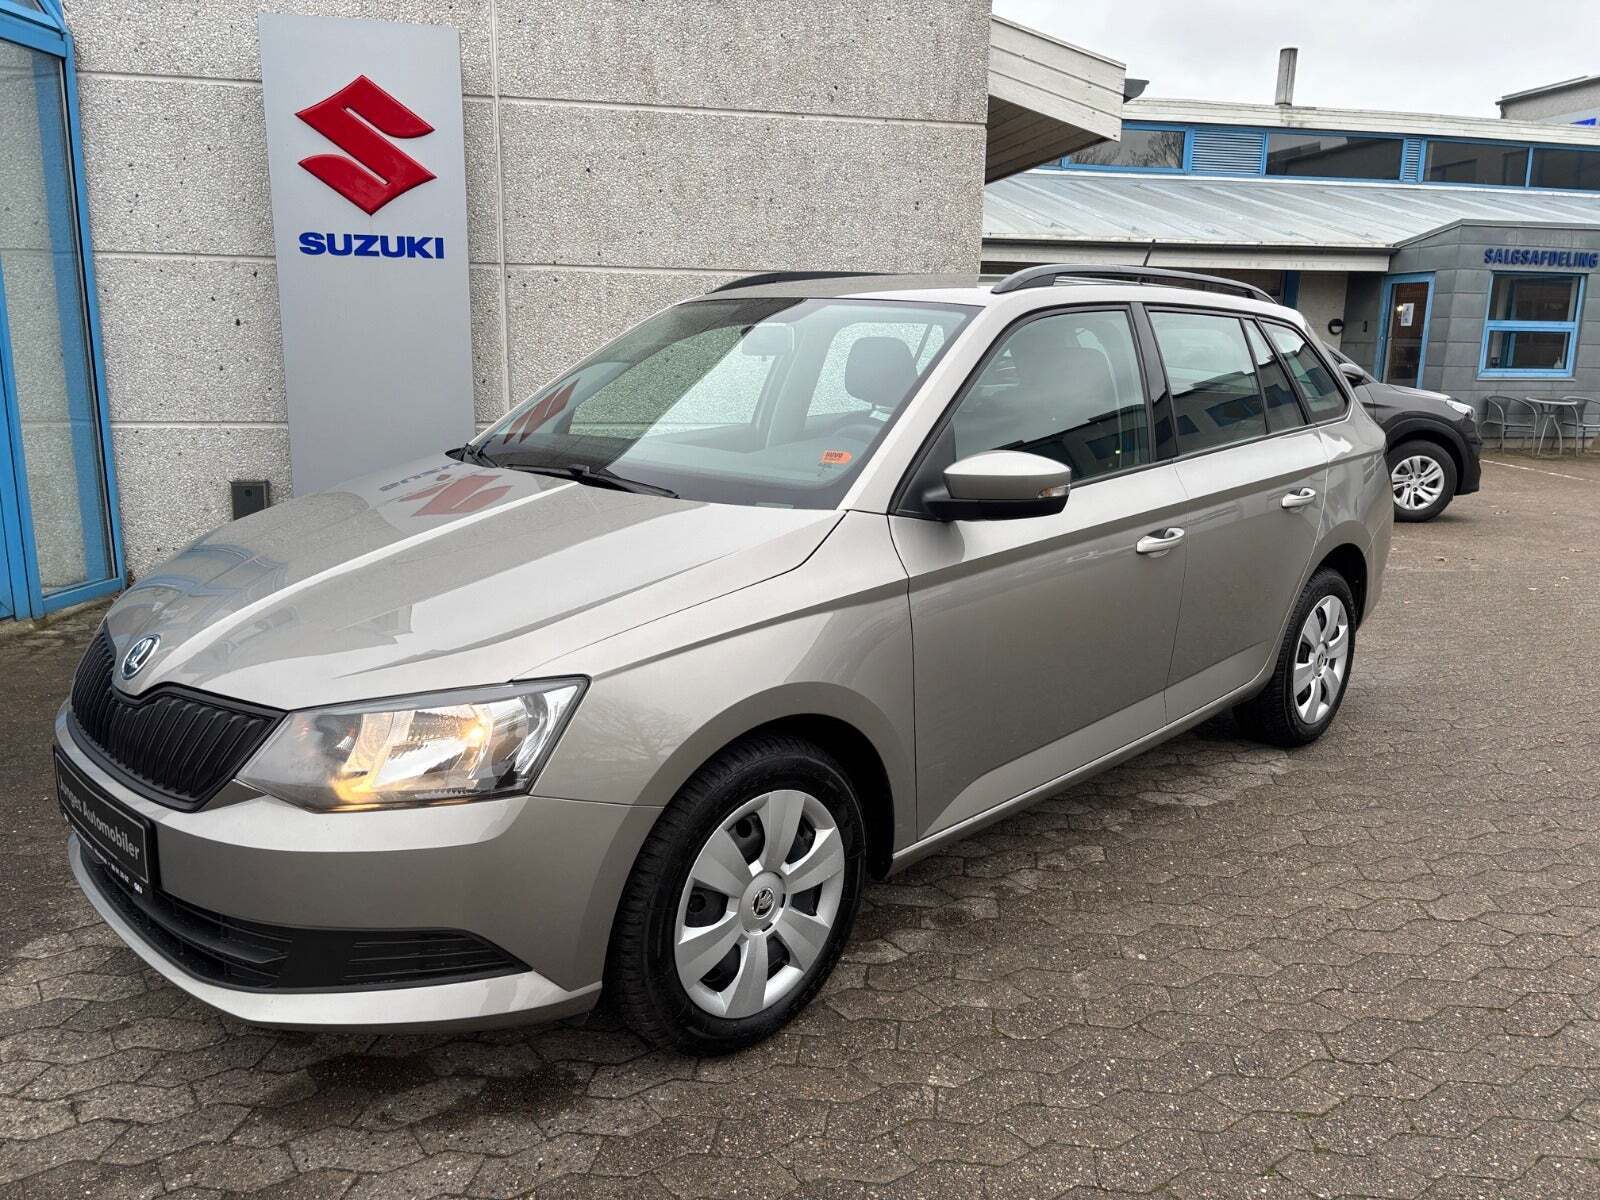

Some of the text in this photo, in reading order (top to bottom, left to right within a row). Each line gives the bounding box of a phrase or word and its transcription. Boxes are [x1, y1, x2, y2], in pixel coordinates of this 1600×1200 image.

[299, 232, 445, 259] SUZUKI
[1484, 248, 1598, 268] SALGSAFDELING
[83, 801, 140, 860] Automobiler
